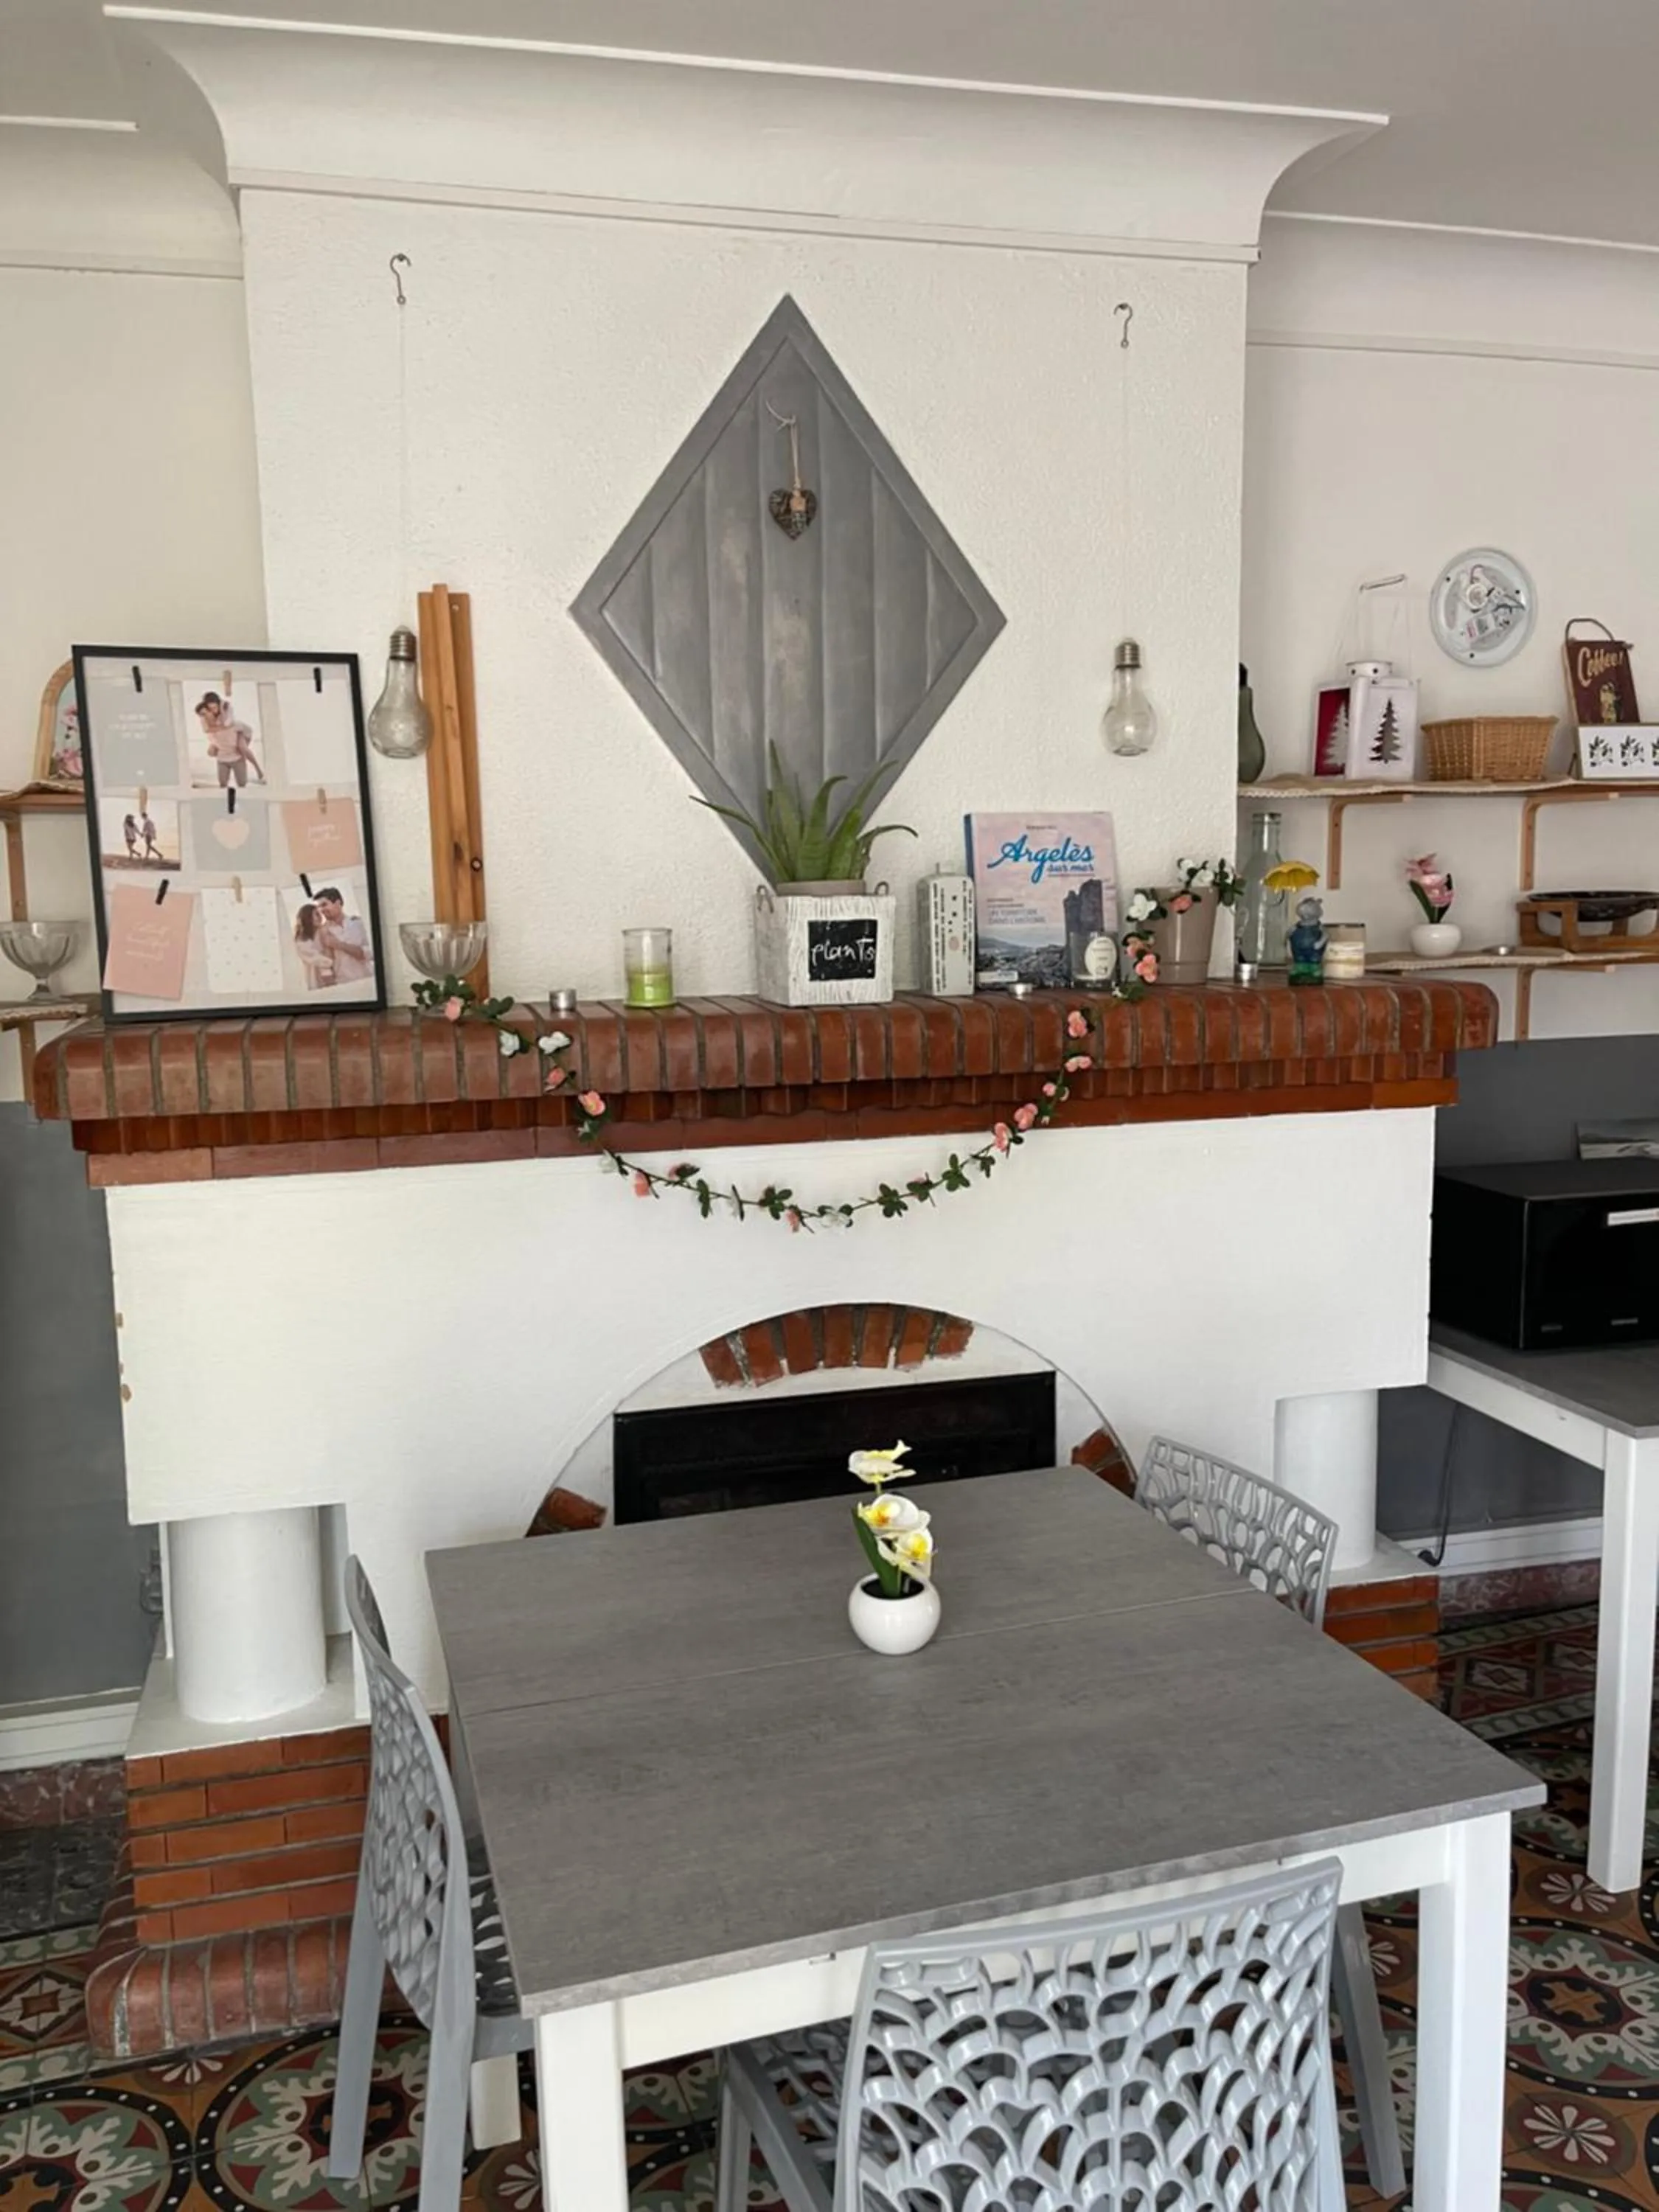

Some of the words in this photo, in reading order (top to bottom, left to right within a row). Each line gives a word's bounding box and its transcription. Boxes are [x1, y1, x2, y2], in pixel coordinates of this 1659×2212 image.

[987, 834, 1094, 884] Argelès
[1048, 863, 1068, 872] sur
[1070, 863, 1094, 872] mer
